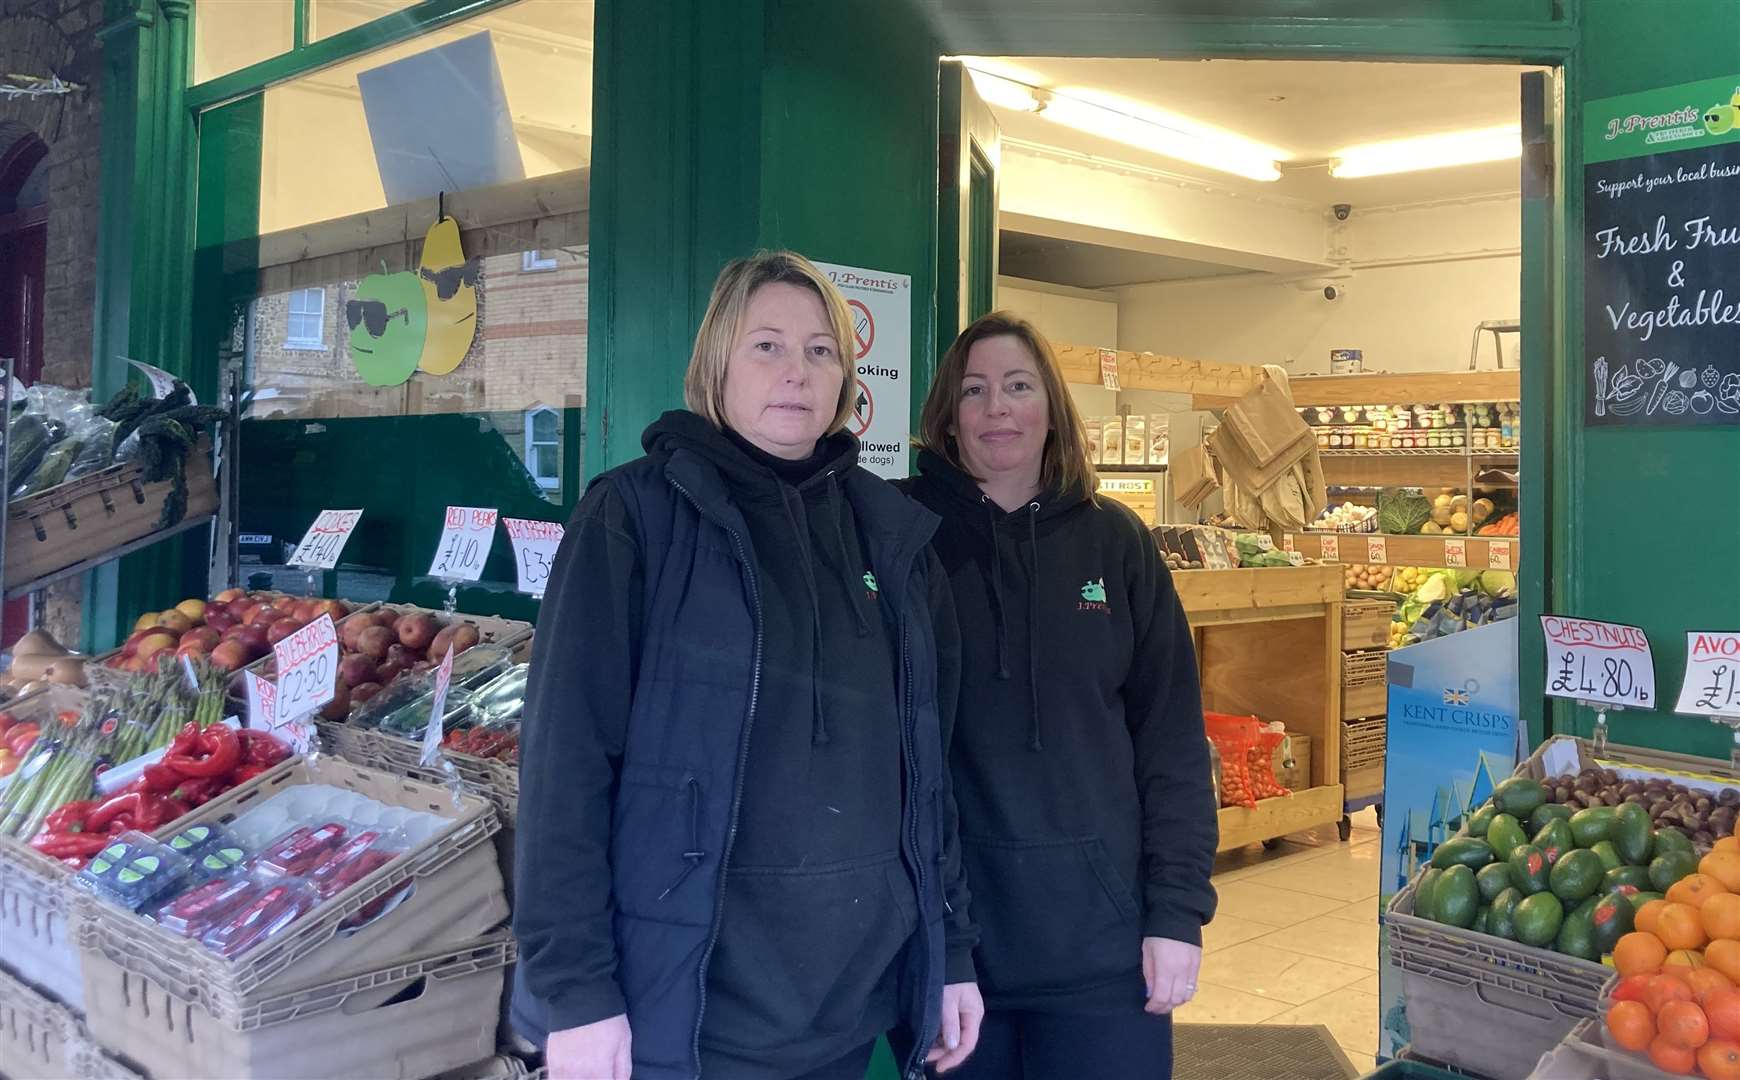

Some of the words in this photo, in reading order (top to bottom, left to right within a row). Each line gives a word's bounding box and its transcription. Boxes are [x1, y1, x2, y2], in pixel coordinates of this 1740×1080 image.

[1596, 173, 1644, 199] Support
[1646, 174, 1674, 192] your
[1677, 163, 1708, 183] local
[1596, 215, 1678, 258] Fresh
[1668, 260, 1685, 287] &
[857, 364, 899, 380] oking
[861, 440, 901, 453] llowed
[869, 455, 894, 466] dogs)
[447, 507, 466, 528] RED
[472, 509, 497, 528] PEARS
[1544, 618, 1648, 648] CHESTNUTS
[1692, 634, 1740, 656] AVO
[280, 654, 328, 718] £2.50
[1552, 651, 1633, 697] £4.80
[1634, 686, 1649, 701] lb
[1403, 704, 1448, 723] KENT
[1451, 709, 1513, 730] CRISPS
